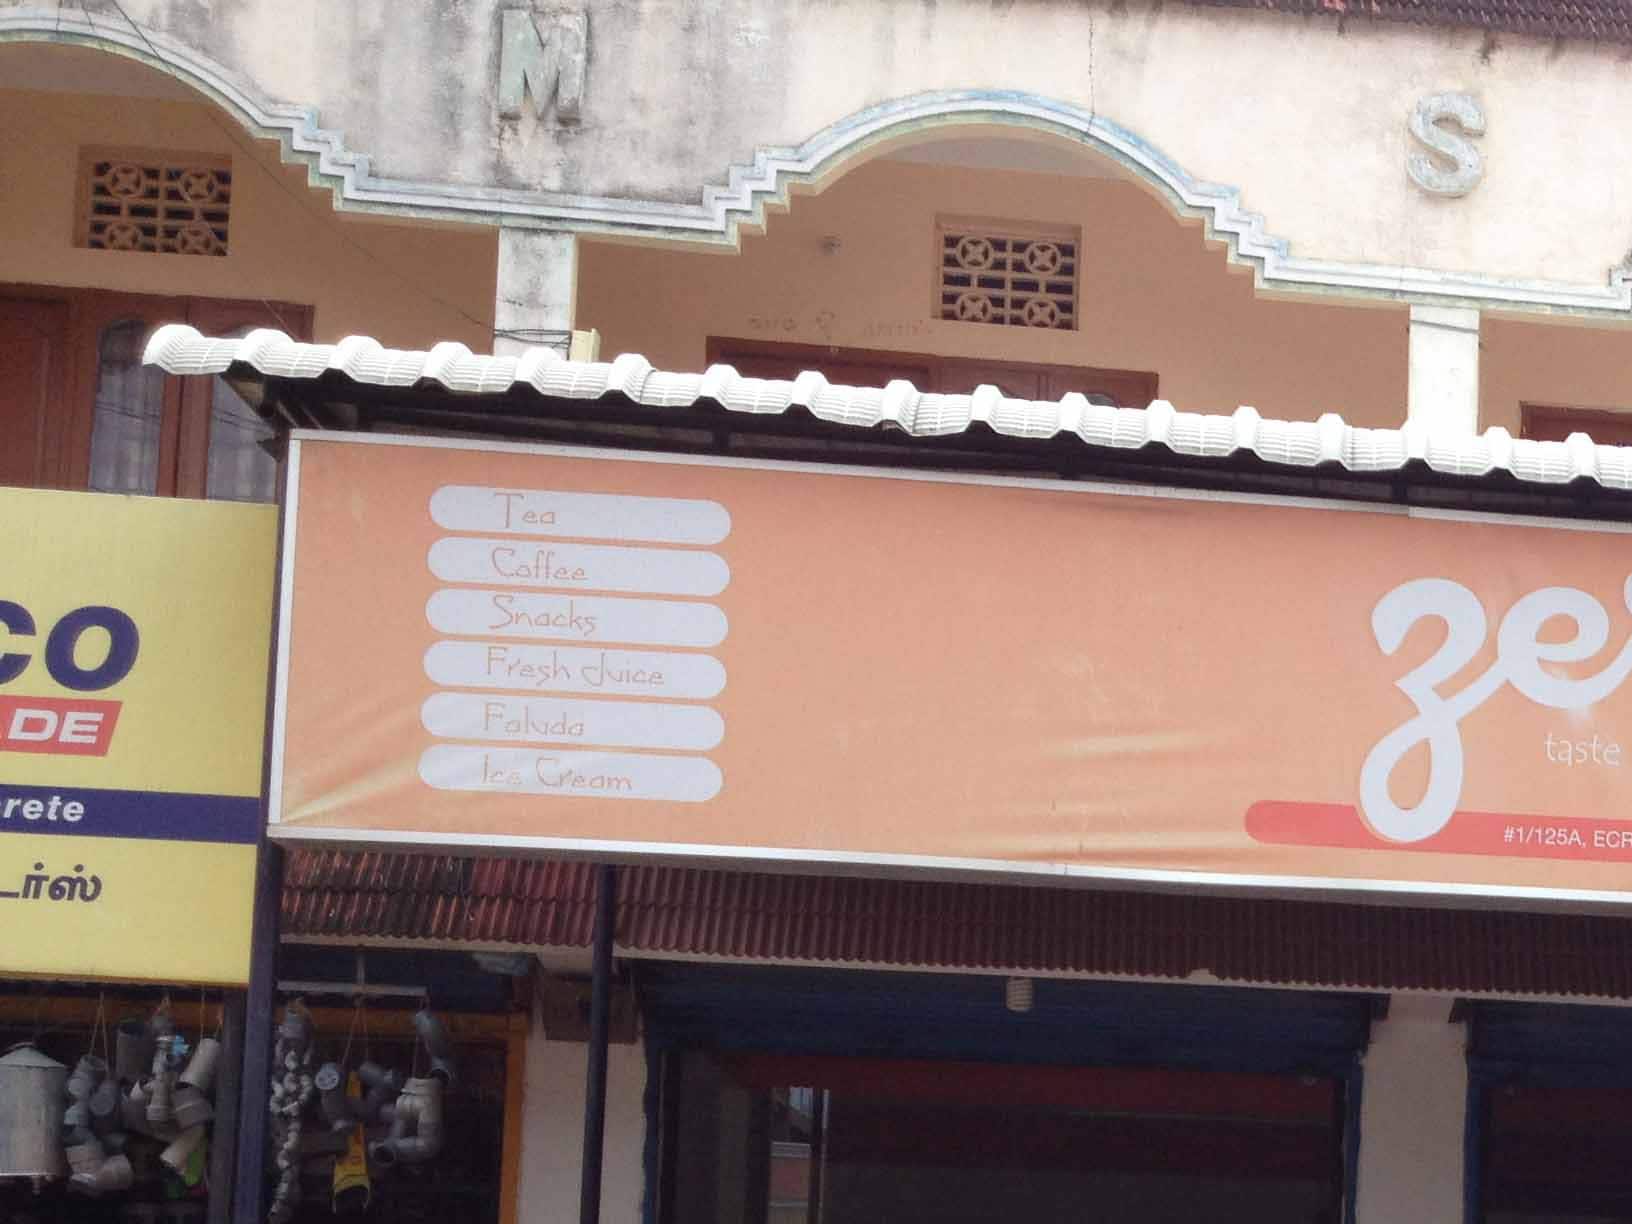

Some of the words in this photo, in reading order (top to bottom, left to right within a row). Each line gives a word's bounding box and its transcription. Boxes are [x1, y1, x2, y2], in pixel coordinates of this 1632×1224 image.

[500, 8, 588, 118] M
[1407, 94, 1486, 195] S
[493, 492, 557, 529] Tea
[490, 546, 590, 581] Coffee
[487, 594, 597, 637] Snacks
[486, 645, 571, 687] Fresh
[580, 651, 666, 687] Juice
[482, 701, 585, 737] Faluda
[1544, 731, 1621, 769] taste
[481, 753, 523, 785] Ice
[535, 756, 634, 792] Cream
[1503, 825, 1587, 848] #1/125A,
